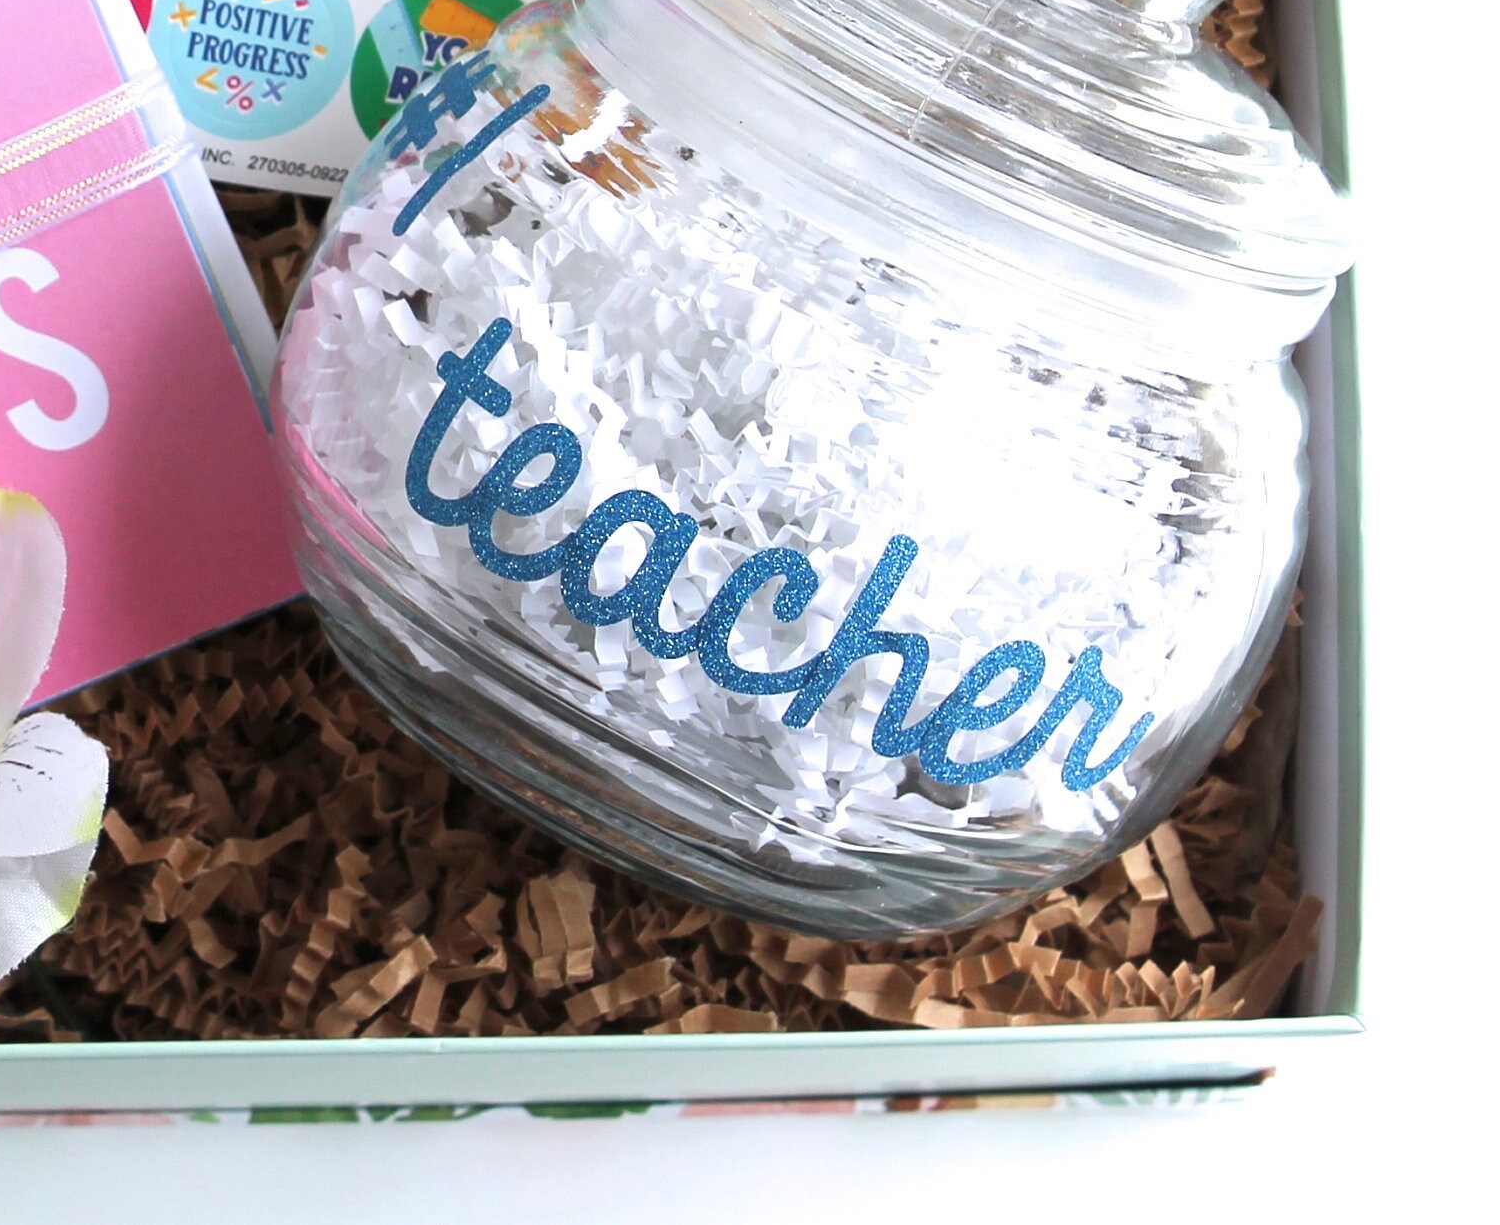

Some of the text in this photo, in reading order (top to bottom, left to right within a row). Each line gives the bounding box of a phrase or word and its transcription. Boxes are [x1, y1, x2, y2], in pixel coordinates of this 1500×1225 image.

[199, 0, 314, 46] POSITIVE
[186, 32, 311, 81] PROGRESS
[423, 32, 469, 64] YO
[201, 147, 349, 182] INC. 270305-0922
[405, 317, 1155, 792] teacher
